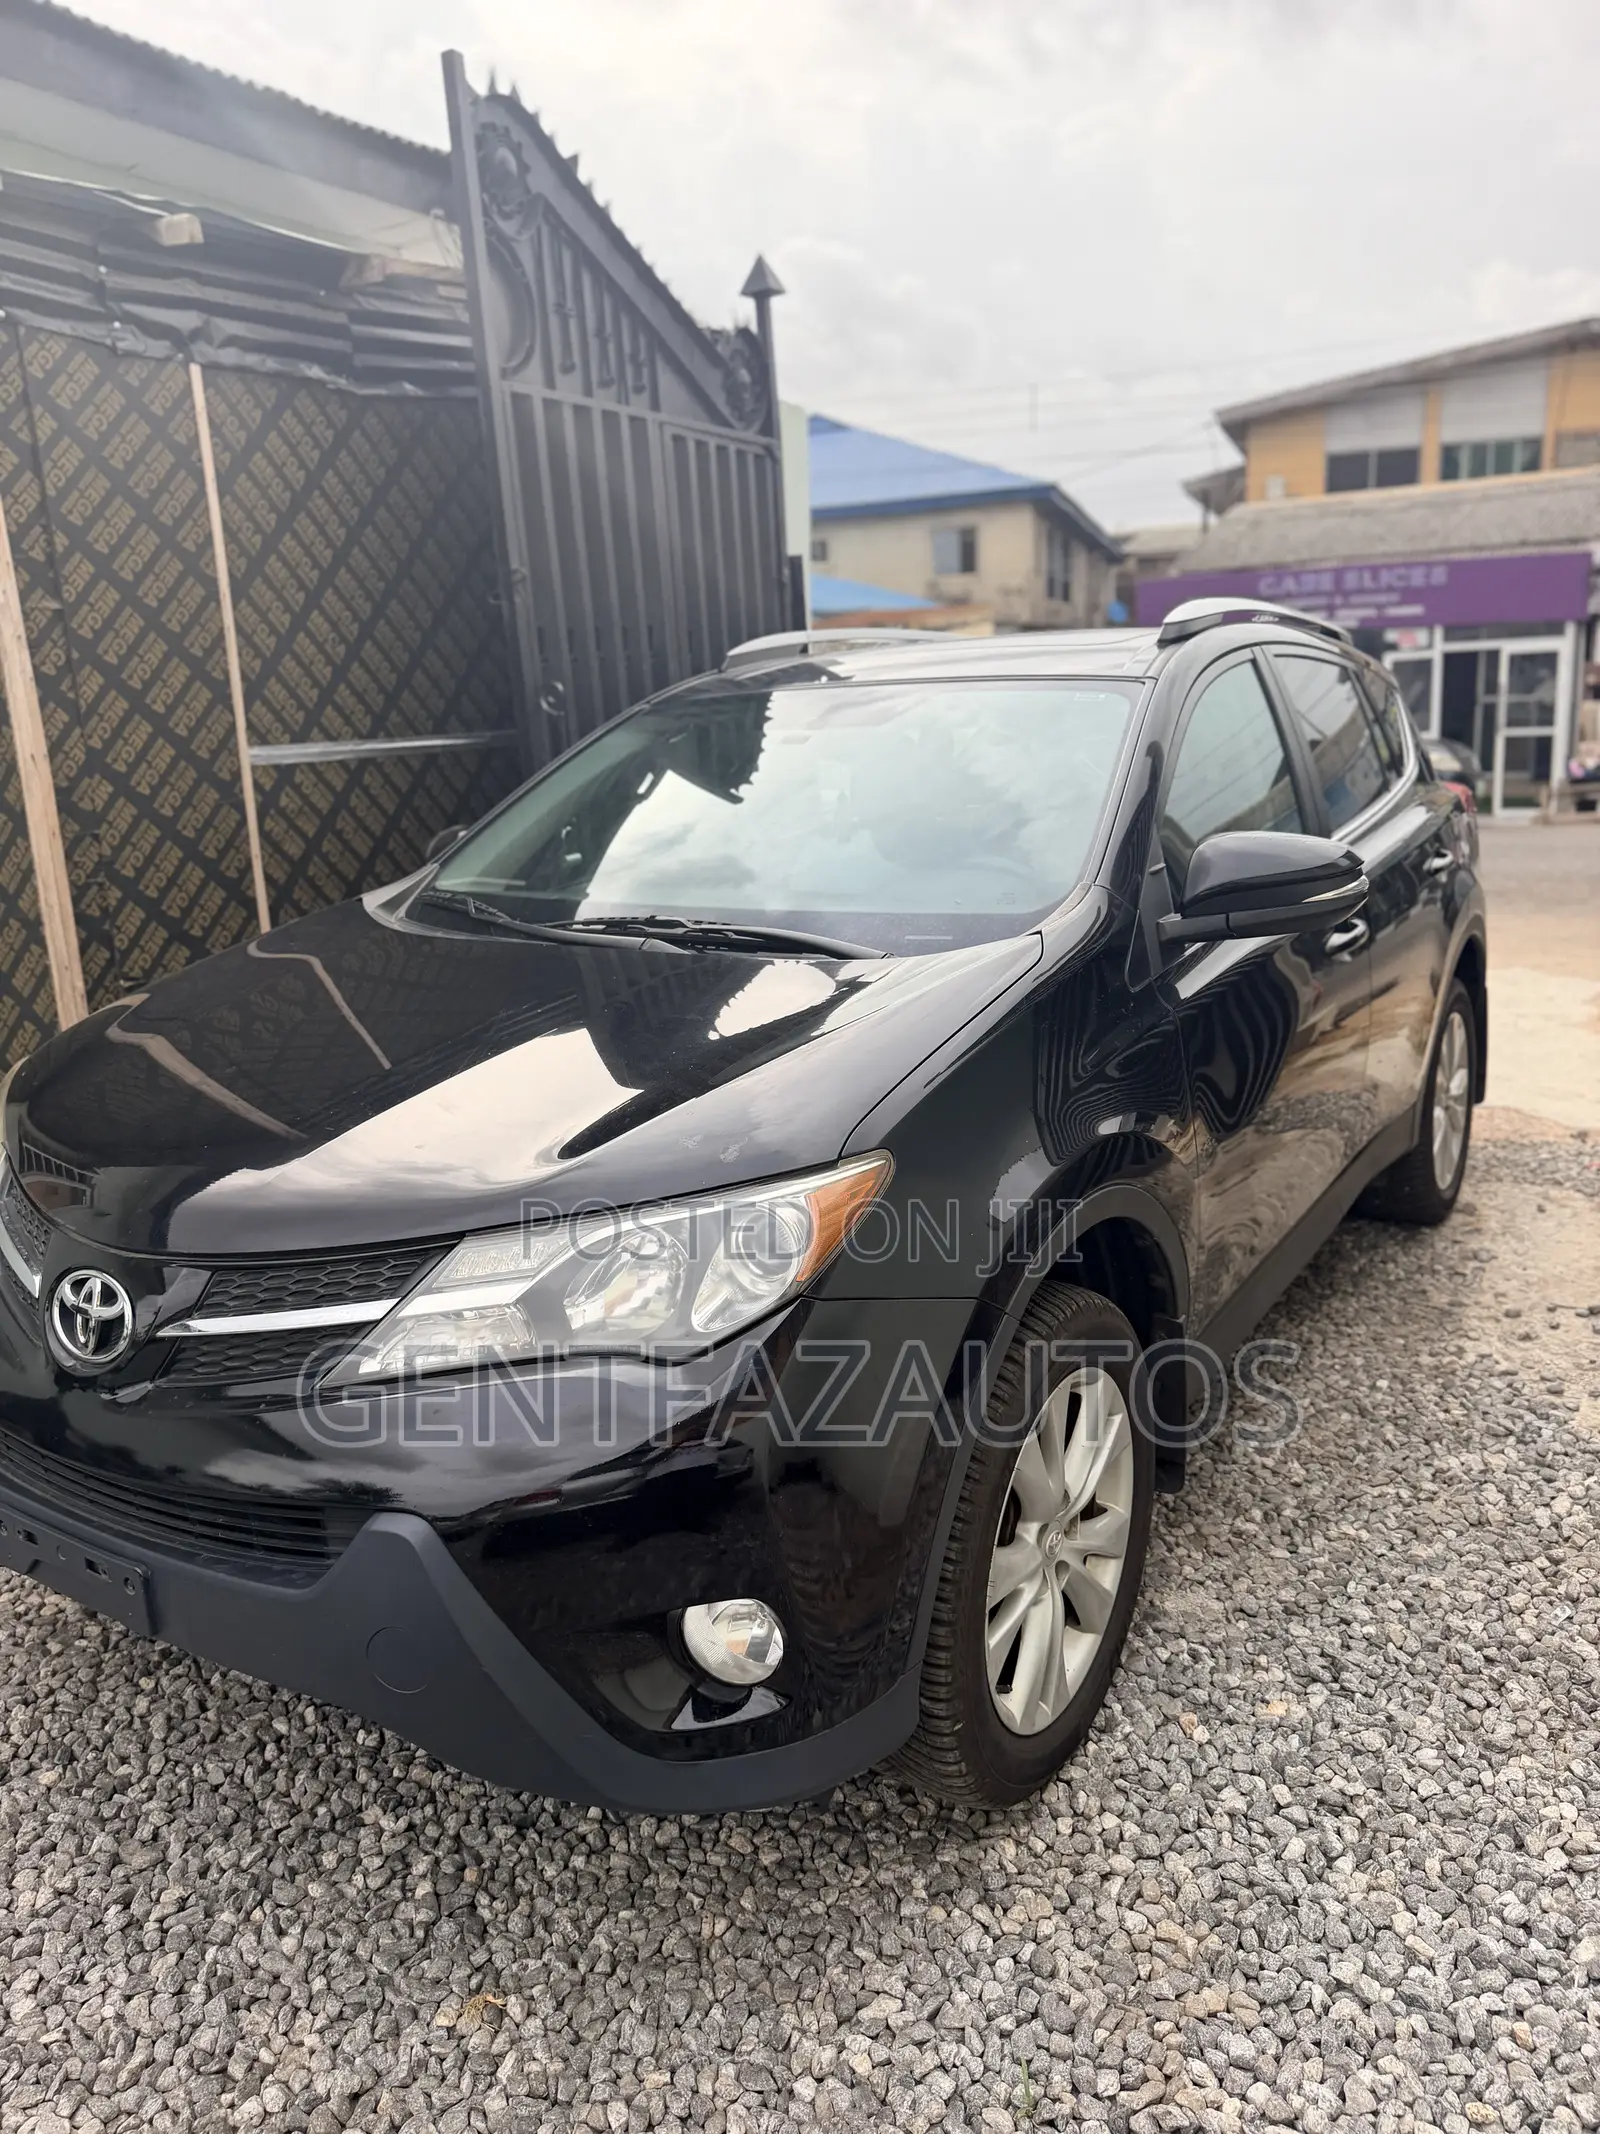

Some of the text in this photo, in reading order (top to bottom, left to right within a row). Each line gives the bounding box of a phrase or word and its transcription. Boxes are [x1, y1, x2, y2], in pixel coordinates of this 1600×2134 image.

[56, 357, 100, 409] MEGA
[151, 366, 188, 416] MEGA
[82, 388, 126, 440] MEGA
[108, 419, 151, 470] MEGA
[133, 447, 175, 498] MEGA
[67, 473, 111, 526] MEGA
[157, 475, 197, 525] MEGA
[94, 501, 136, 554] MEGA
[119, 529, 160, 582] MEGA
[144, 554, 184, 608] MEGA
[77, 583, 121, 639] MEGA
[167, 579, 205, 633] MEGA
[104, 612, 145, 665] MEGA
[128, 637, 168, 690] MEGA
[152, 662, 191, 714] MEGA
[175, 685, 212, 737] MEGA
[87, 692, 129, 749] MEGA
[112, 716, 153, 773] MEGA
[197, 707, 234, 759] MEGA
[136, 741, 175, 796] MEGA
[159, 762, 198, 817] MEGA
[101, 800, 138, 857] MEGA
[182, 786, 220, 839] MEGA
[204, 805, 241, 859] MEGA
[121, 822, 161, 878] MEGA
[144, 843, 183, 898] MEGA
[167, 864, 205, 918] MEGA
[189, 885, 227, 937] MEGA
[12, 944, 42, 993] MEGA
